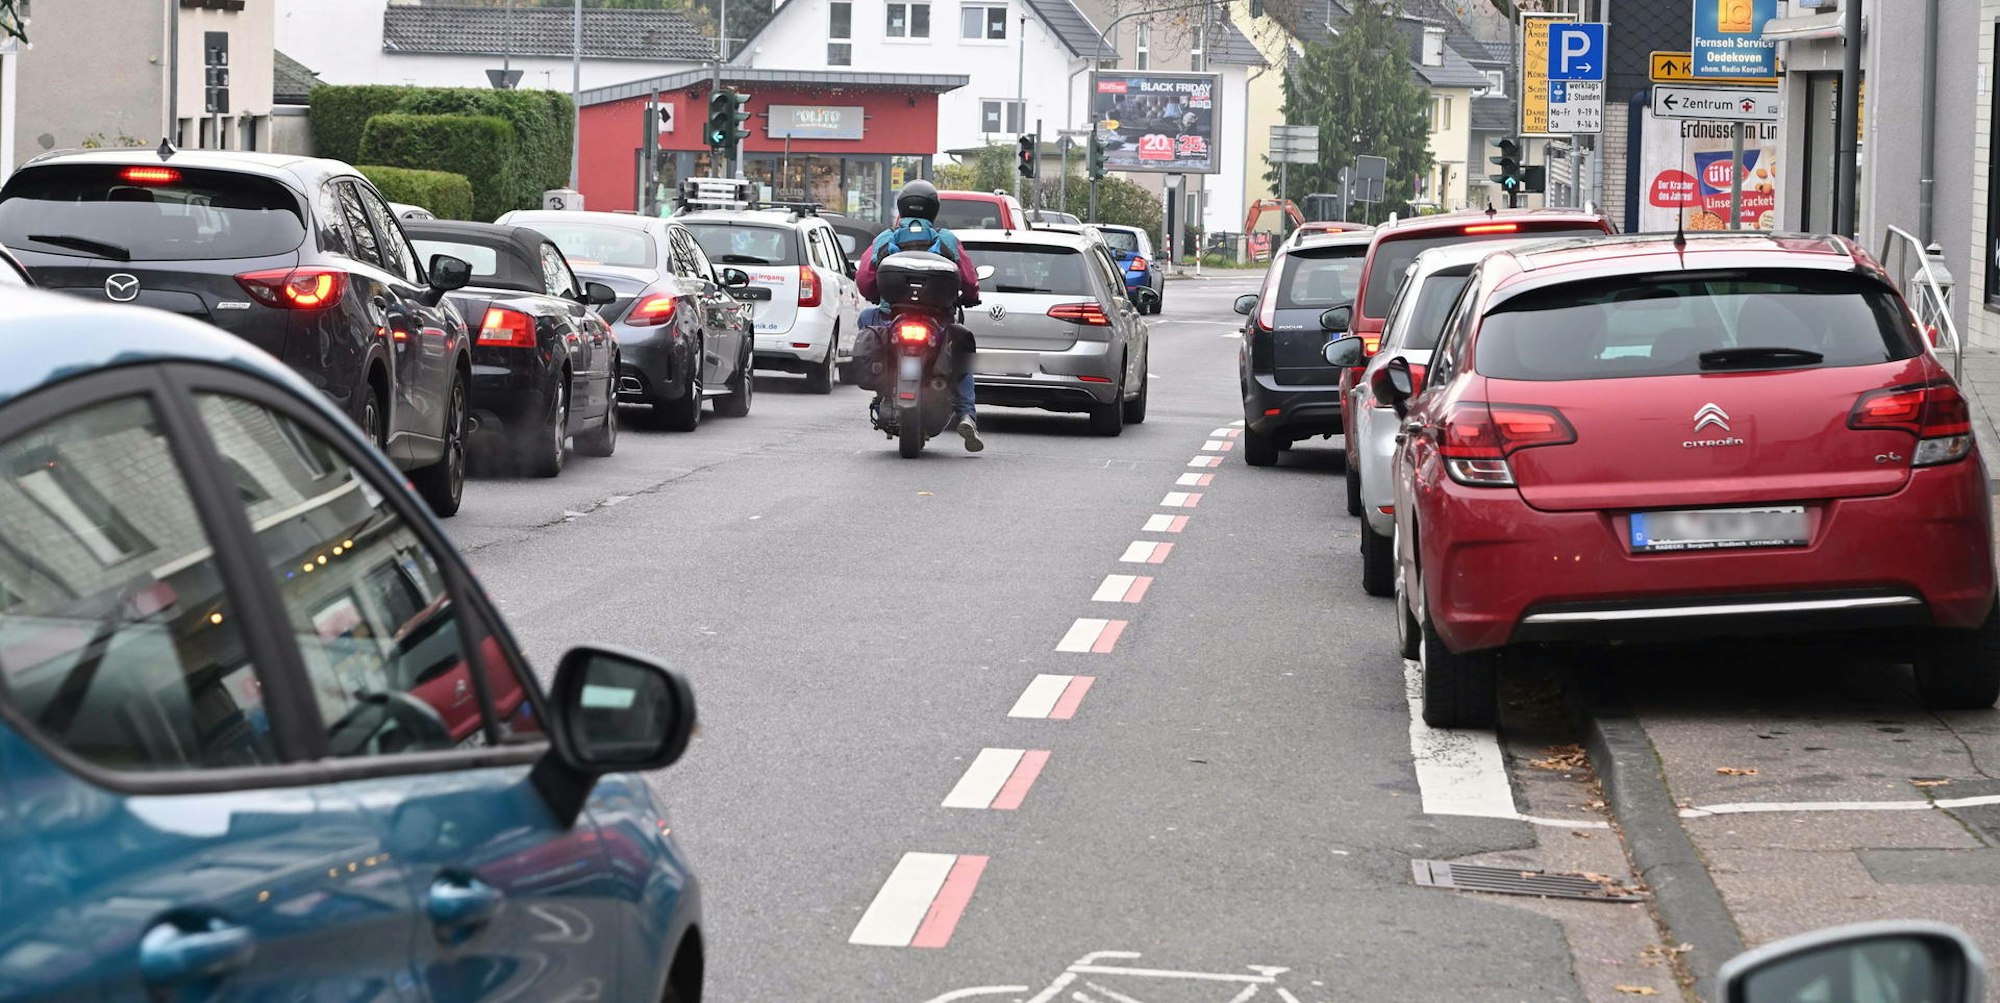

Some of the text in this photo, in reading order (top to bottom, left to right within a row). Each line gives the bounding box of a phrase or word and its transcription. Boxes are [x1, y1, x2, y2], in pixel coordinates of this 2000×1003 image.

[1695, 36, 1774, 48] Fernseh Service
[1561, 30, 1591, 74] P
[1707, 51, 1762, 62] Oedekoven
[1682, 63, 1692, 74] K
[1721, 65, 1740, 73] Radio
[1140, 82, 1212, 93] BLACK FRIDAY
[1570, 81, 1599, 91] werktags
[1567, 92, 1601, 101] 2 Stunden
[1682, 97, 1733, 110] Zentrum
[1551, 107, 1600, 116] Mo-Fr 9-19 h
[1551, 120, 1559, 128] Sa
[1594, 120, 1600, 128] h
[1745, 125, 1756, 139] m
[1760, 122, 1777, 140] Lin
[1706, 198, 1731, 209] Linse
[753, 322, 778, 330] nik.de
[1682, 436, 1744, 448] CITROËN
